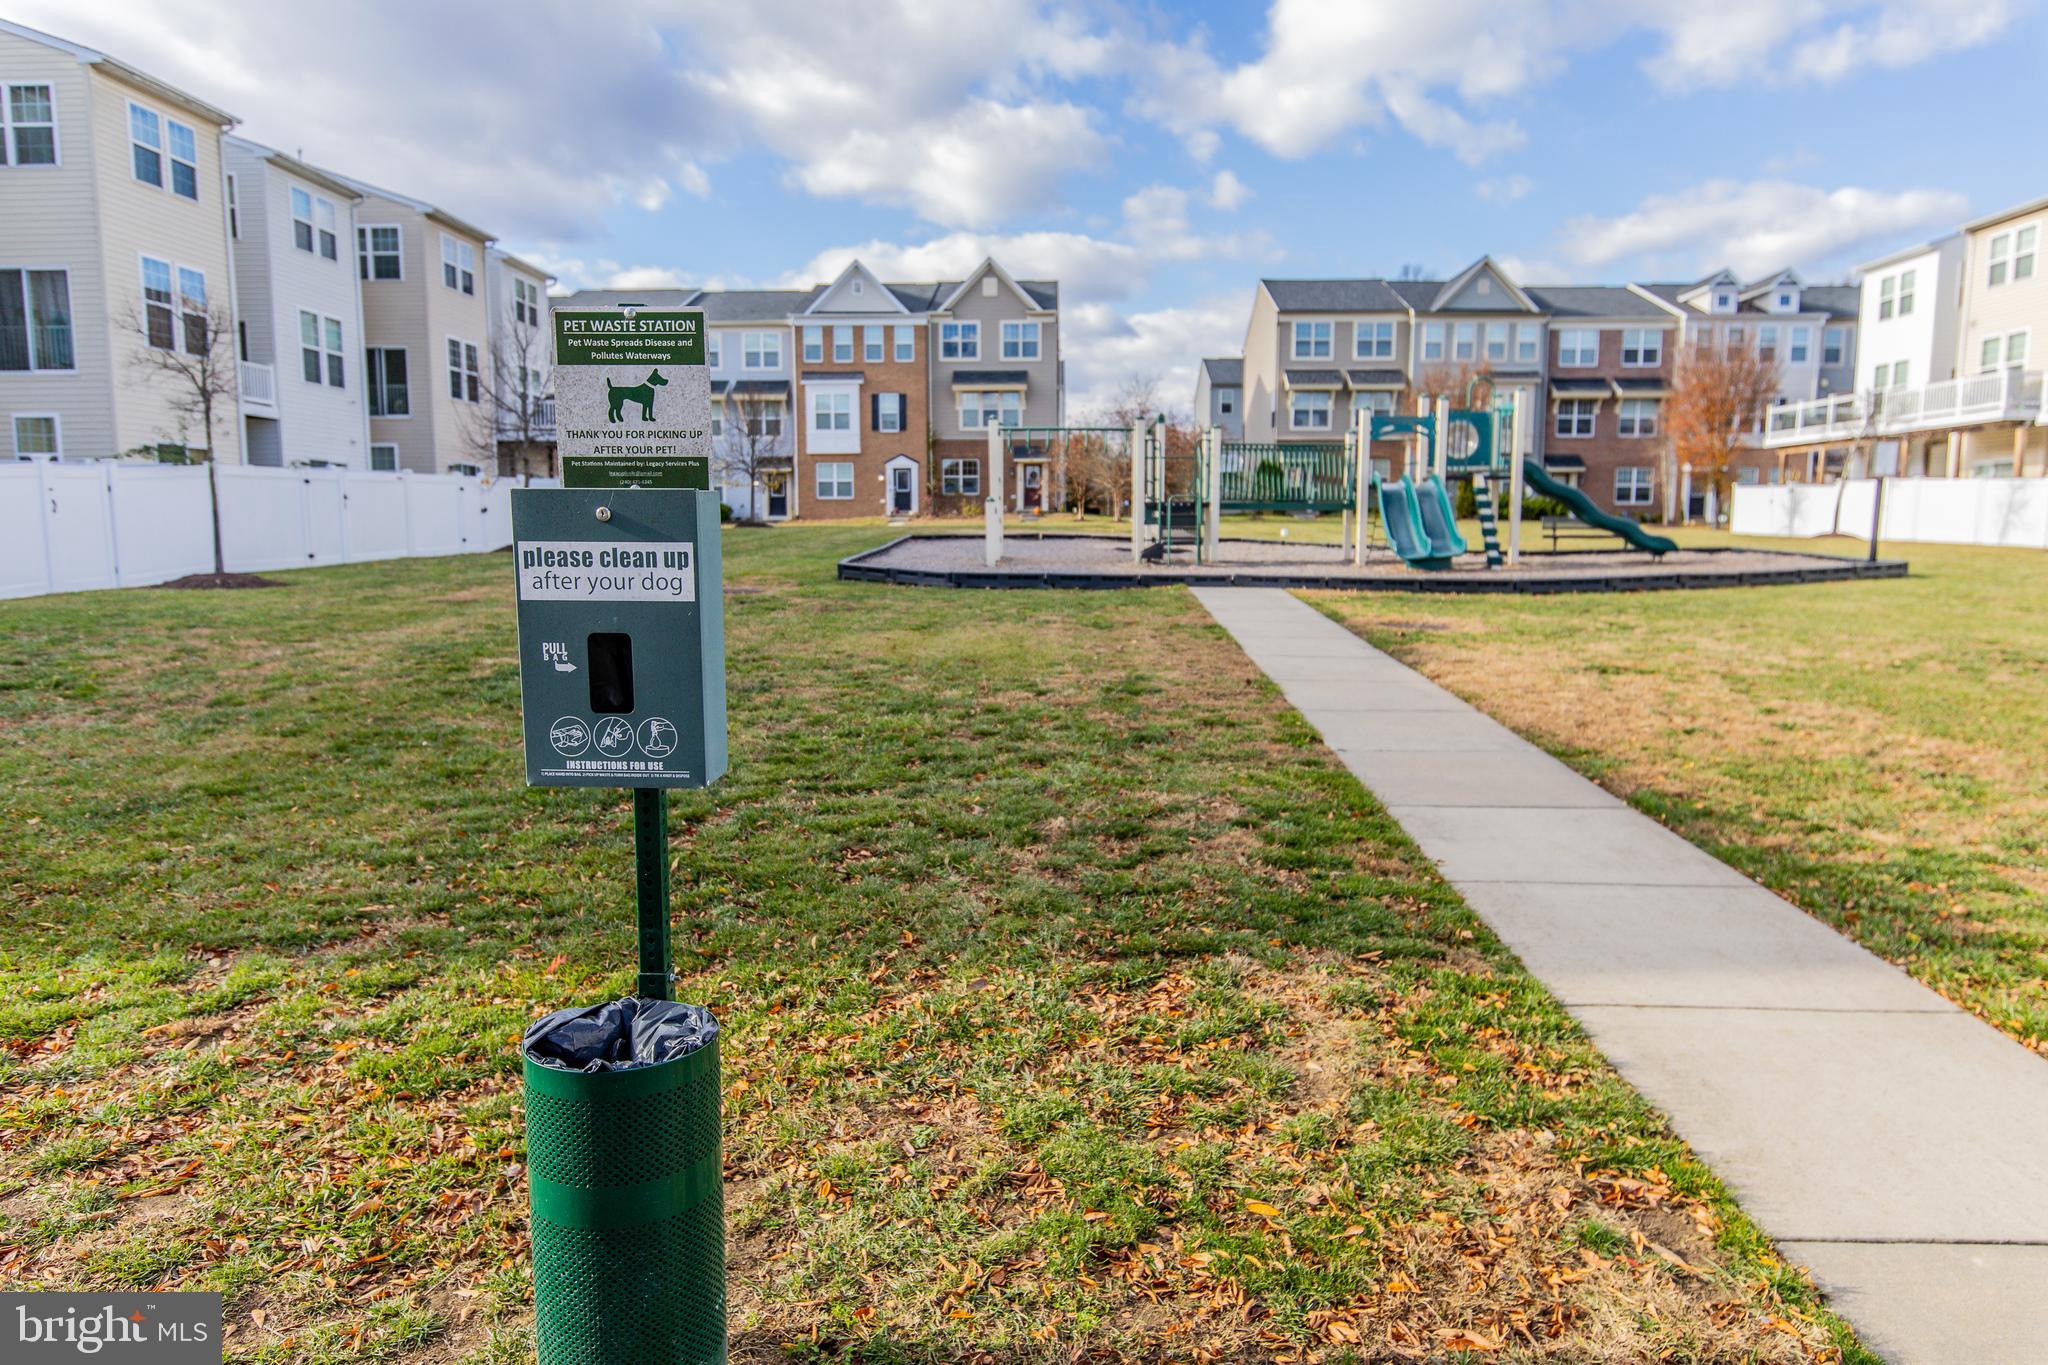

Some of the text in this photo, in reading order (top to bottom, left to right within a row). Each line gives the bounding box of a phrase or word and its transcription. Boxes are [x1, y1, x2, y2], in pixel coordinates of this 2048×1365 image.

[563, 320, 696, 332] PET WASTE STATION
[568, 338, 693, 349] Pet Waste Spreads Disease and
[591, 351, 671, 361] Pollutes Waterways
[566, 430, 703, 439] THANK YOU FOR PICKING UP
[594, 445, 677, 454] AFTER YOUR PET!
[646, 460, 665, 468] Legacy
[523, 547, 689, 570] please clean up
[532, 571, 683, 596] after your dog
[542, 642, 568, 655] PULL
[543, 653, 568, 661] BAG
[566, 760, 664, 770] INSTRUCTIONS FOR USE
